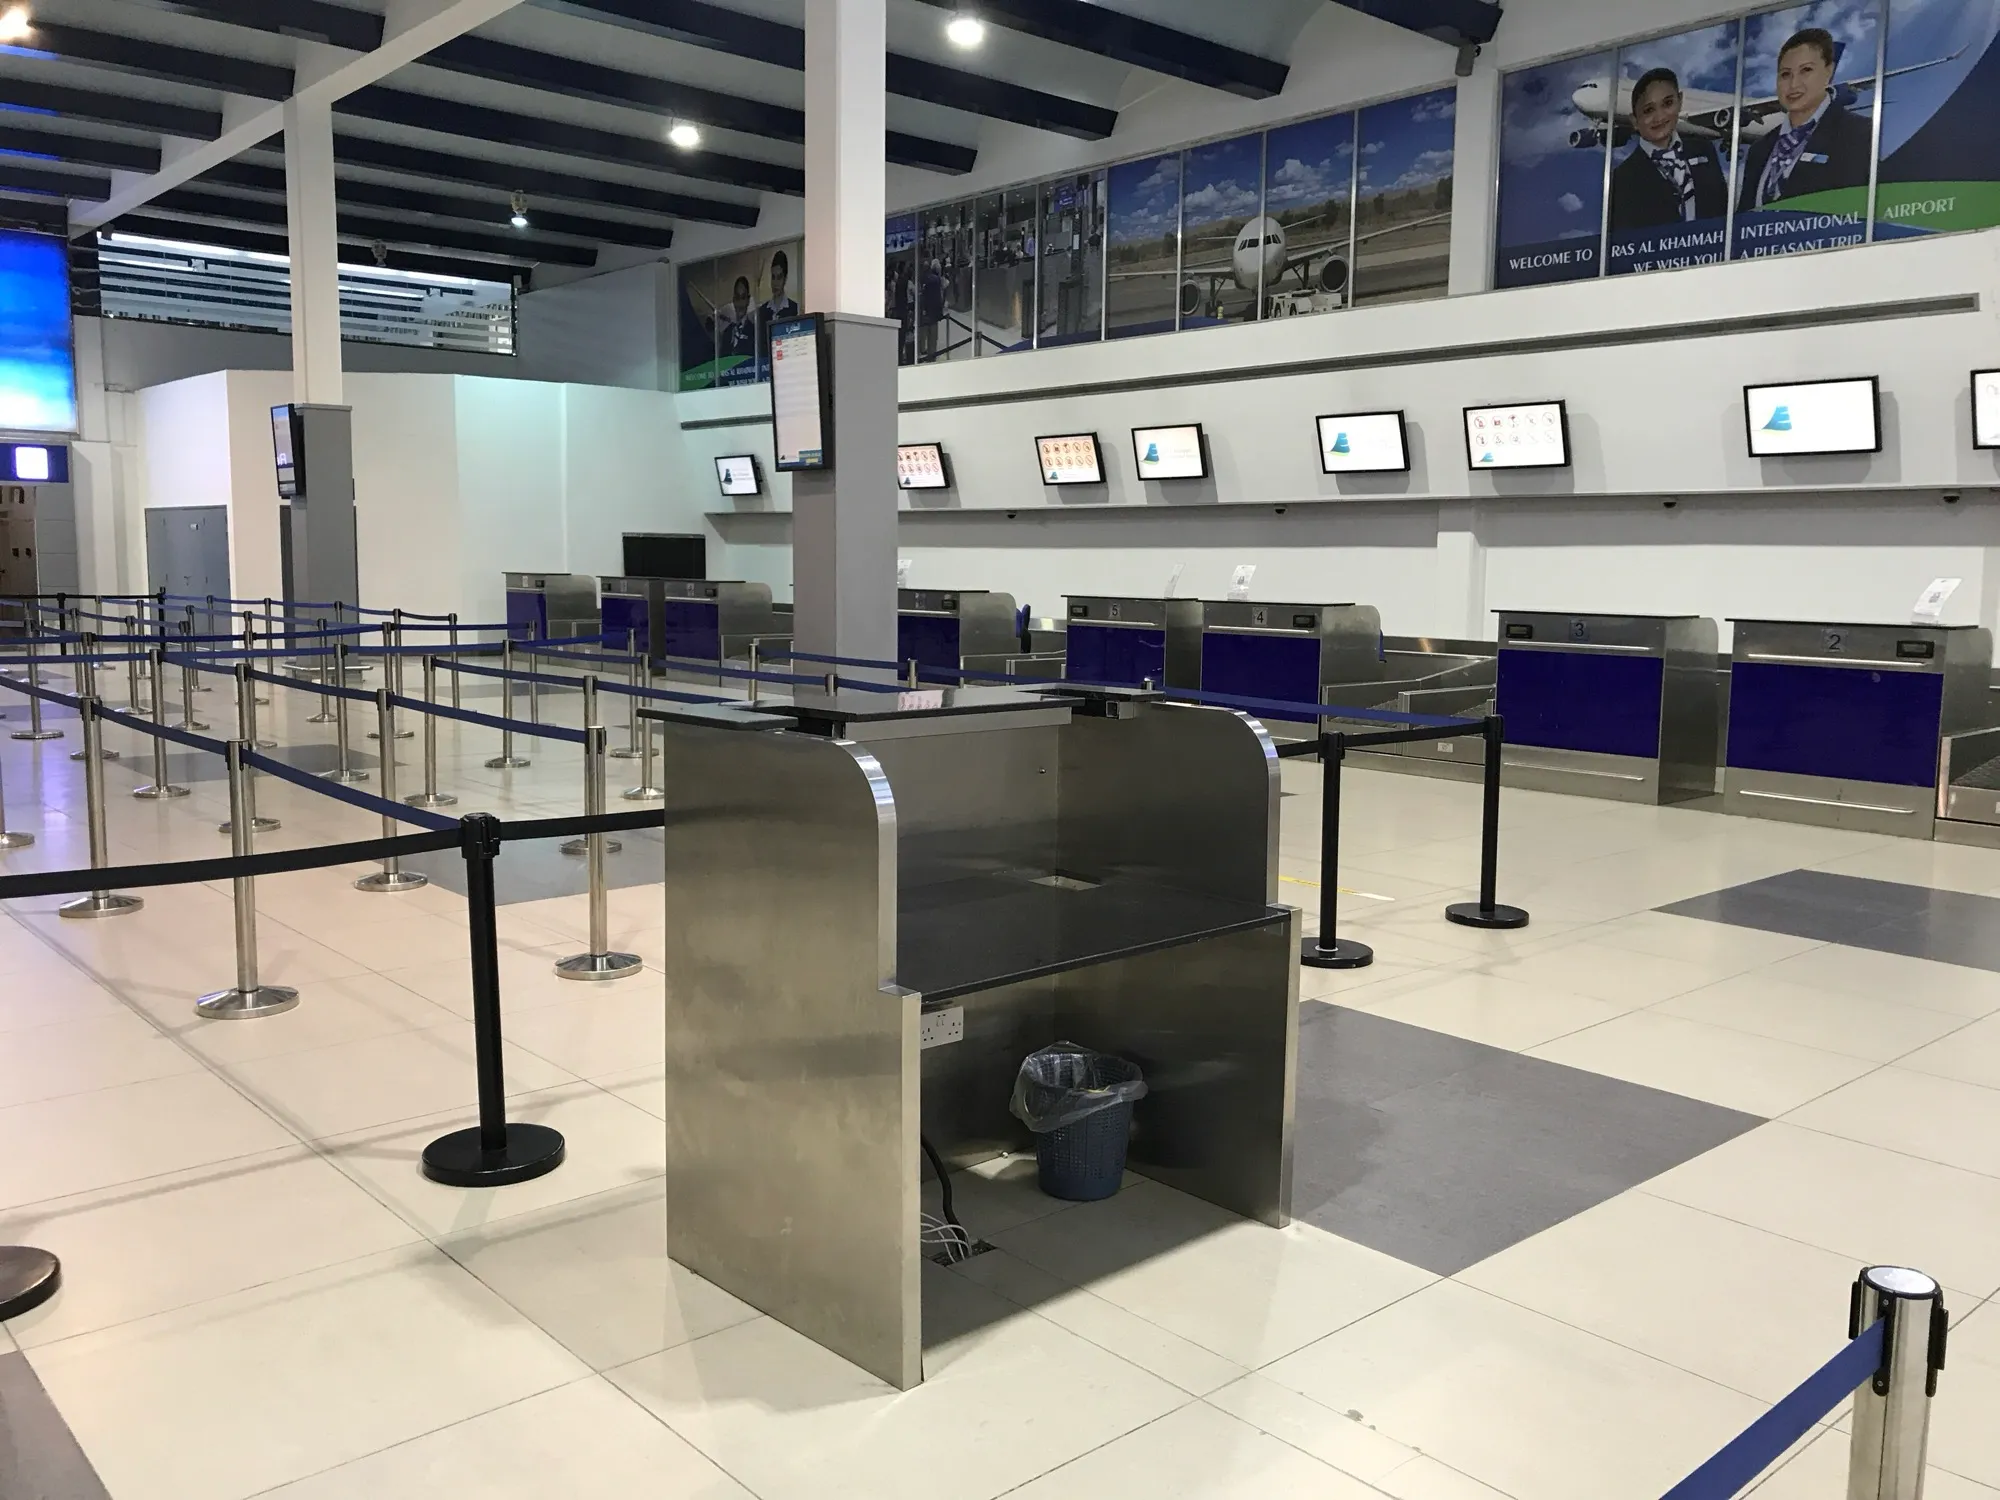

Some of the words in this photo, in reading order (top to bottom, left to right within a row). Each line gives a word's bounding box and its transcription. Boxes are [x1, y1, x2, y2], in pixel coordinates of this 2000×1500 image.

[1509, 250, 1571, 270] WELCOME
[1575, 248, 1593, 262] TO
[1611, 242, 1635, 258] RAS
[1638, 240, 1655, 254] AL
[1659, 230, 1724, 252] KHAIMAH
[1740, 210, 1863, 240] INTERNATIONAL
[1883, 196, 1957, 220] AIRPORT
[1656, 256, 1690, 270] WISH
[1694, 252, 1723, 266] YOU
[1829, 234, 1863, 249] TRIP
[1111, 606, 1119, 616] 5
[1256, 611, 1264, 623] 4
[1574, 622, 1585, 638] 3
[1828, 634, 1841, 650] 2
